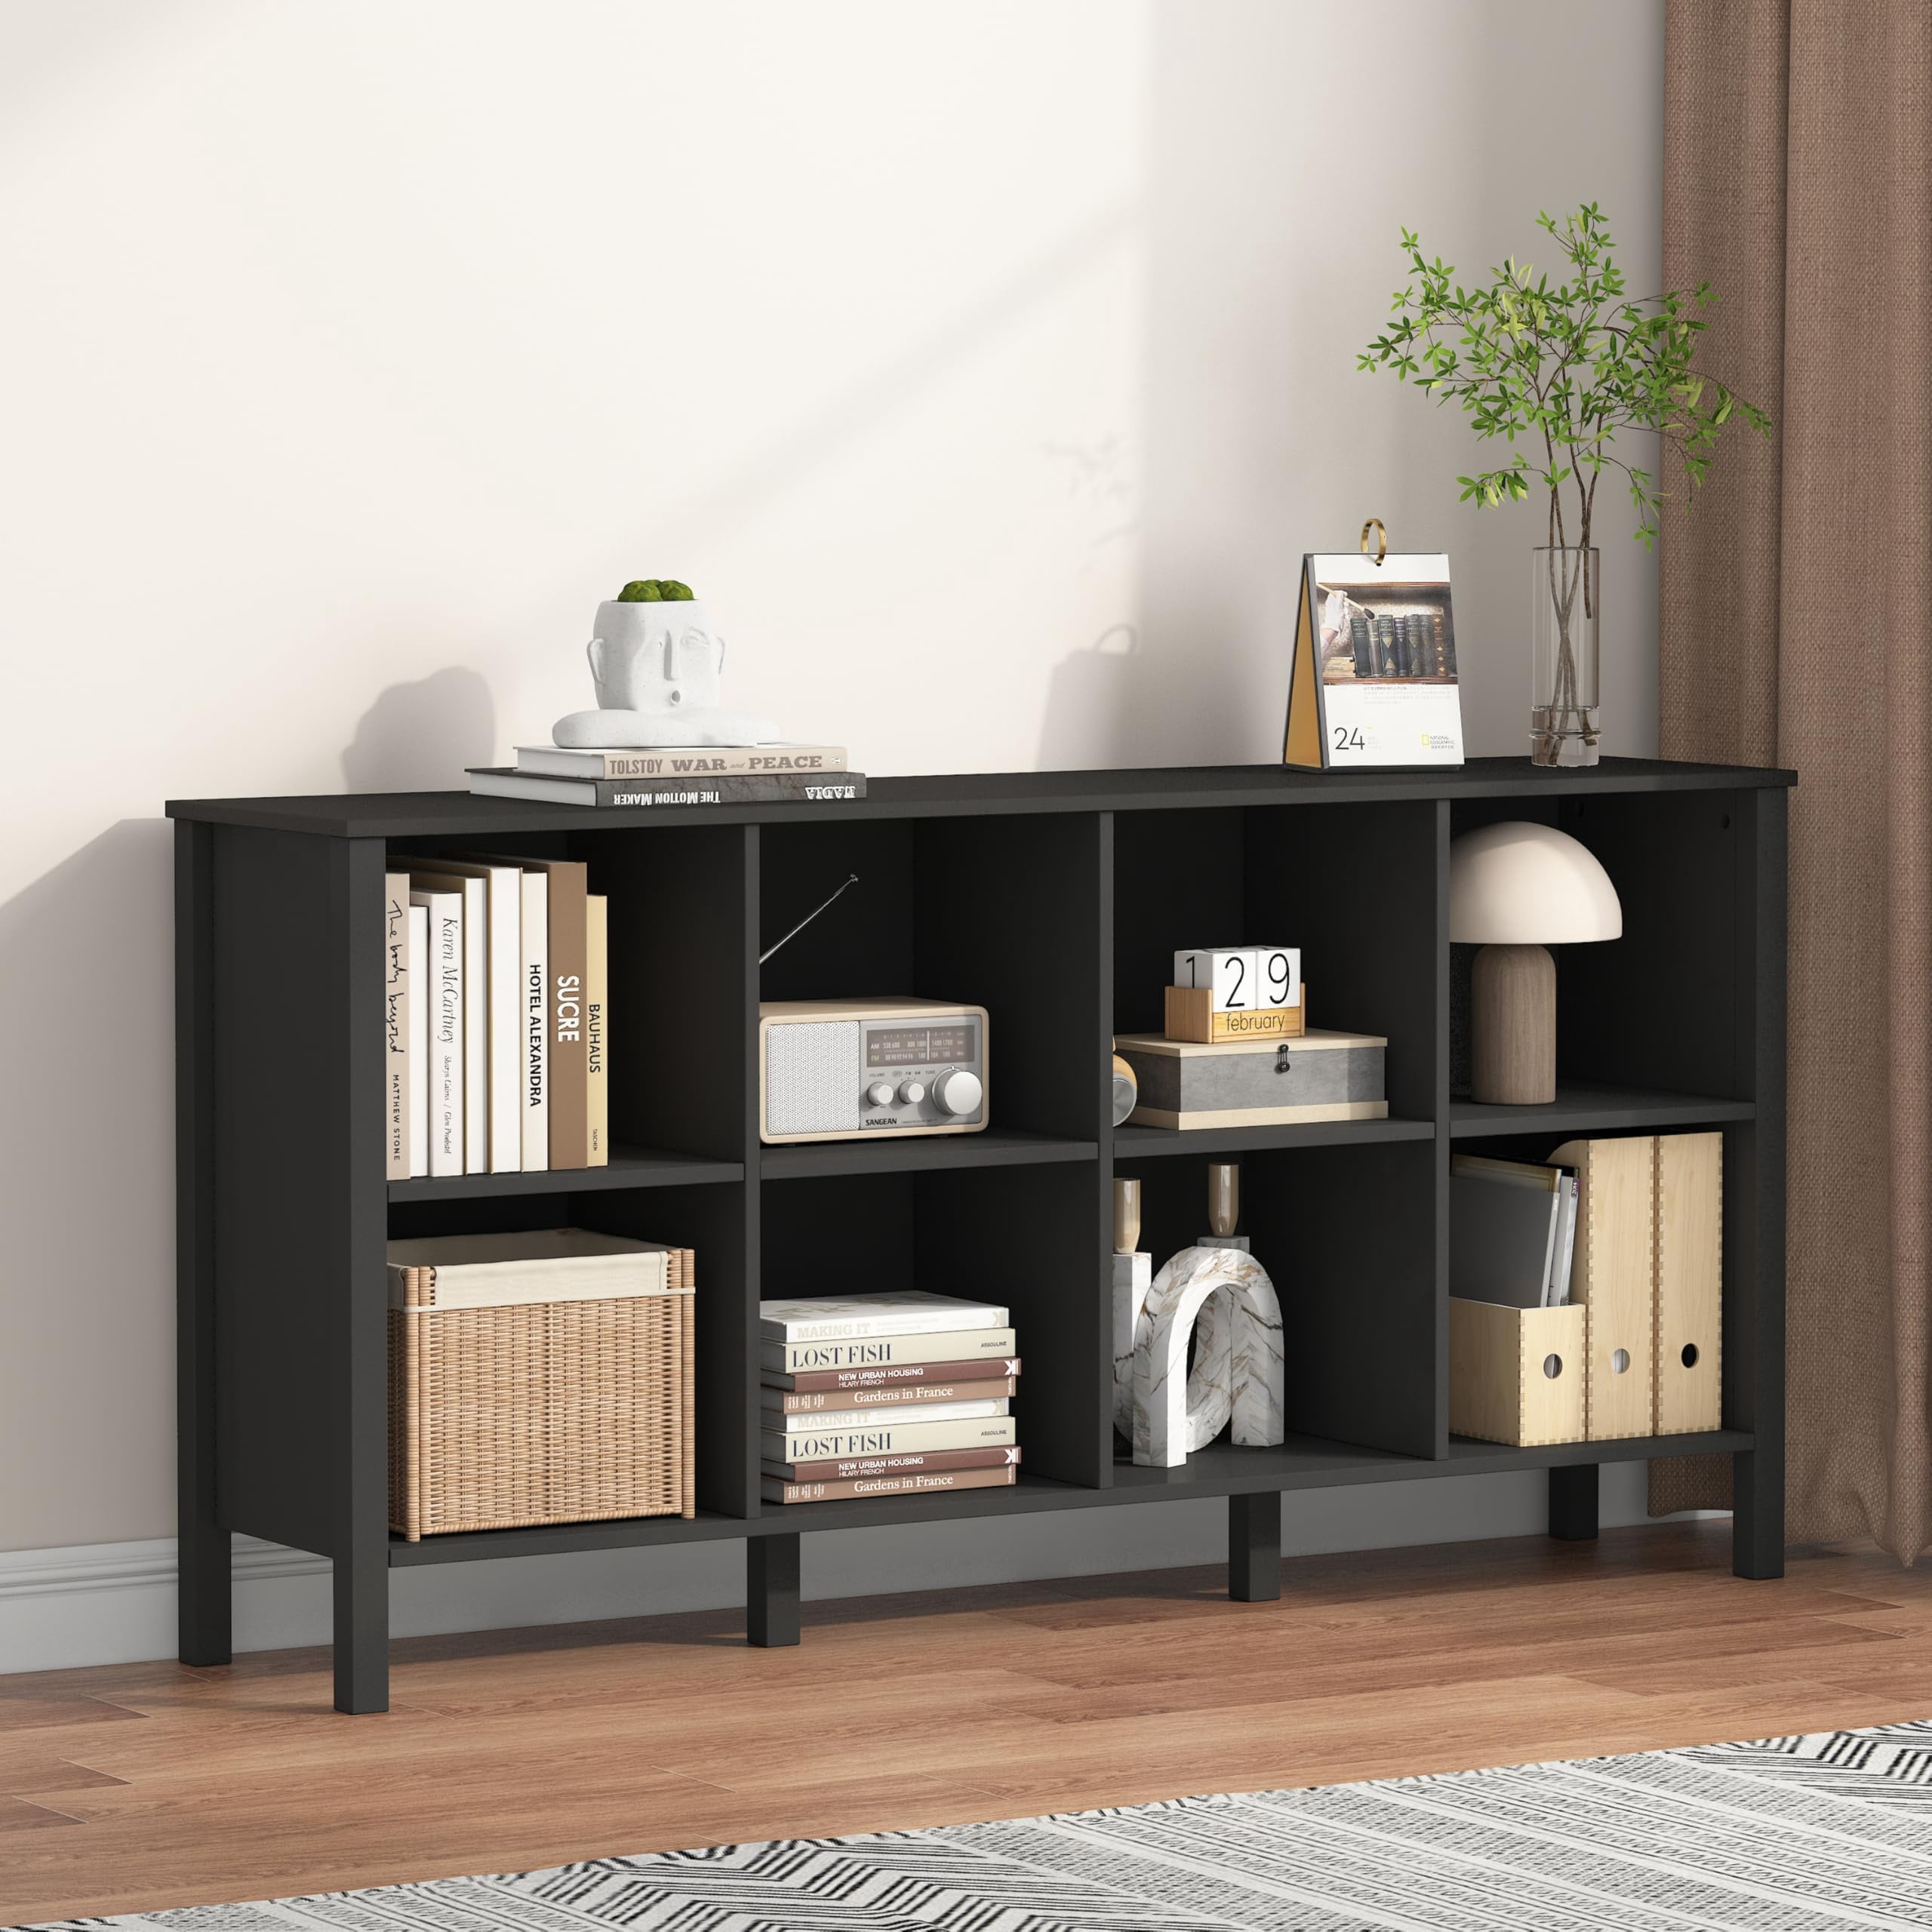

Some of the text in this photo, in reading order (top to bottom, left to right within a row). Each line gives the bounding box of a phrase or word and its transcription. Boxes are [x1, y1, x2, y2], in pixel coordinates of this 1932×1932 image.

[1334, 727, 1365, 750] 24
[609, 758, 663, 774] TOLSTOY
[670, 758, 728, 772] WAR
[748, 755, 823, 770] PEACE
[614, 791, 721, 806] THE MOTION MAKER
[385, 900, 408, 1053] The body beyond
[437, 918, 459, 1044] Karen McCartney
[1186, 955, 1195, 989] 1
[556, 975, 580, 1043] SUCRE
[1226, 1012, 1285, 1032] february
[529, 964, 542, 1107] HOTEL ALEXANDRA
[589, 1004, 601, 1073] BAUHAUS
[392, 1074, 401, 1124] MATTHEW
[866, 1118, 897, 1126] SANGEAN
[797, 1324, 852, 1339] MAKING
[857, 1322, 870, 1334] IT
[793, 1343, 891, 1367] LOST FISH
[858, 1371, 886, 1380] URBAN
[888, 1367, 924, 1377] HOUSING
[854, 1386, 954, 1404] Gardens in France
[797, 1414, 852, 1429] MAKING
[857, 1412, 870, 1423] IT
[793, 1433, 891, 1457] LOST FISH
[838, 1457, 924, 1471] NEW URBAN HOUSING
[854, 1475, 954, 1492] Gardens in France
